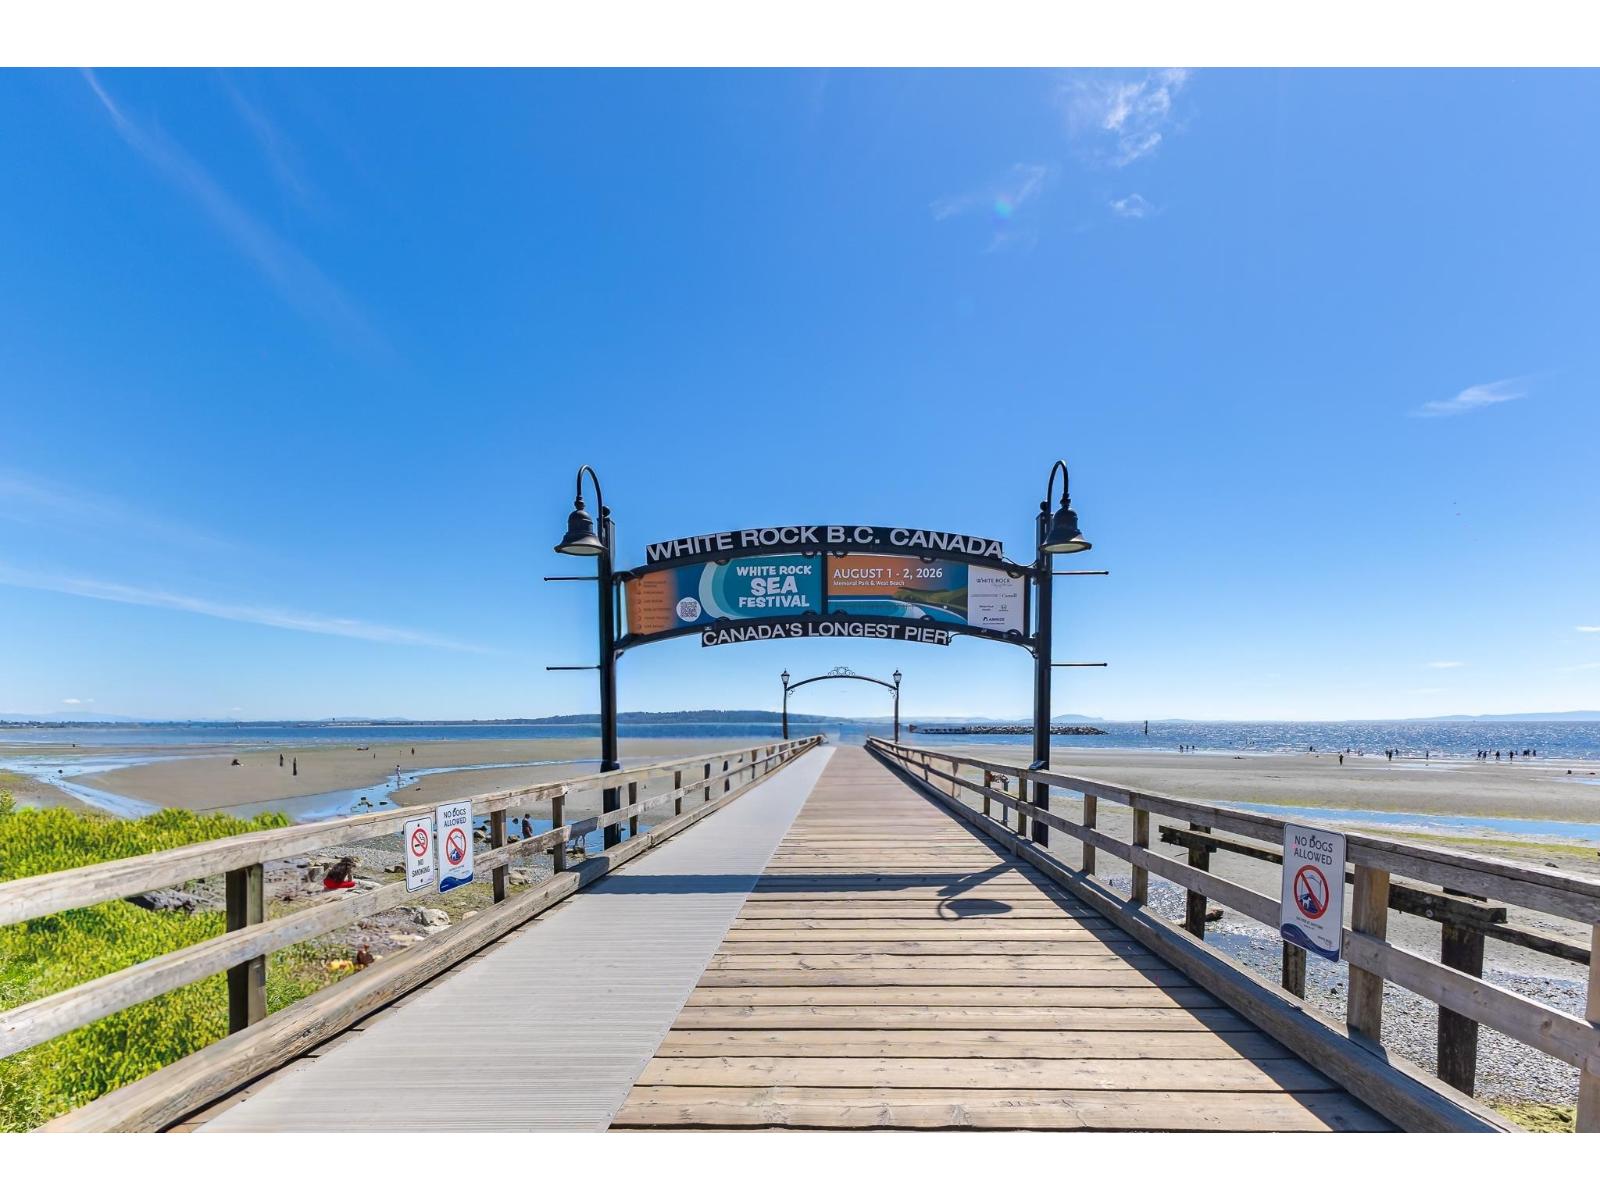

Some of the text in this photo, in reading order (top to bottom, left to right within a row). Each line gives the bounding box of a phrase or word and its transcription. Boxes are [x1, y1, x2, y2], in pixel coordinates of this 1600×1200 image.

[646, 526, 1003, 561] WHITE ROCK B.C. CANADA
[736, 565, 812, 577] WHITE ROCK
[833, 568, 884, 579] AUGUST
[886, 568, 892, 578] 1
[903, 568, 913, 580] 2,
[916, 568, 943, 578] 2026
[751, 576, 798, 596] SEA
[738, 596, 810, 608] FESTIVAL
[703, 622, 948, 646] CANADA'S LONGEST PIER
[443, 808, 467, 819] NO DOGS
[443, 816, 467, 827] ALLOWED
[1294, 835, 1333, 853] NO DOGS
[1293, 847, 1333, 866] ALLOWED
